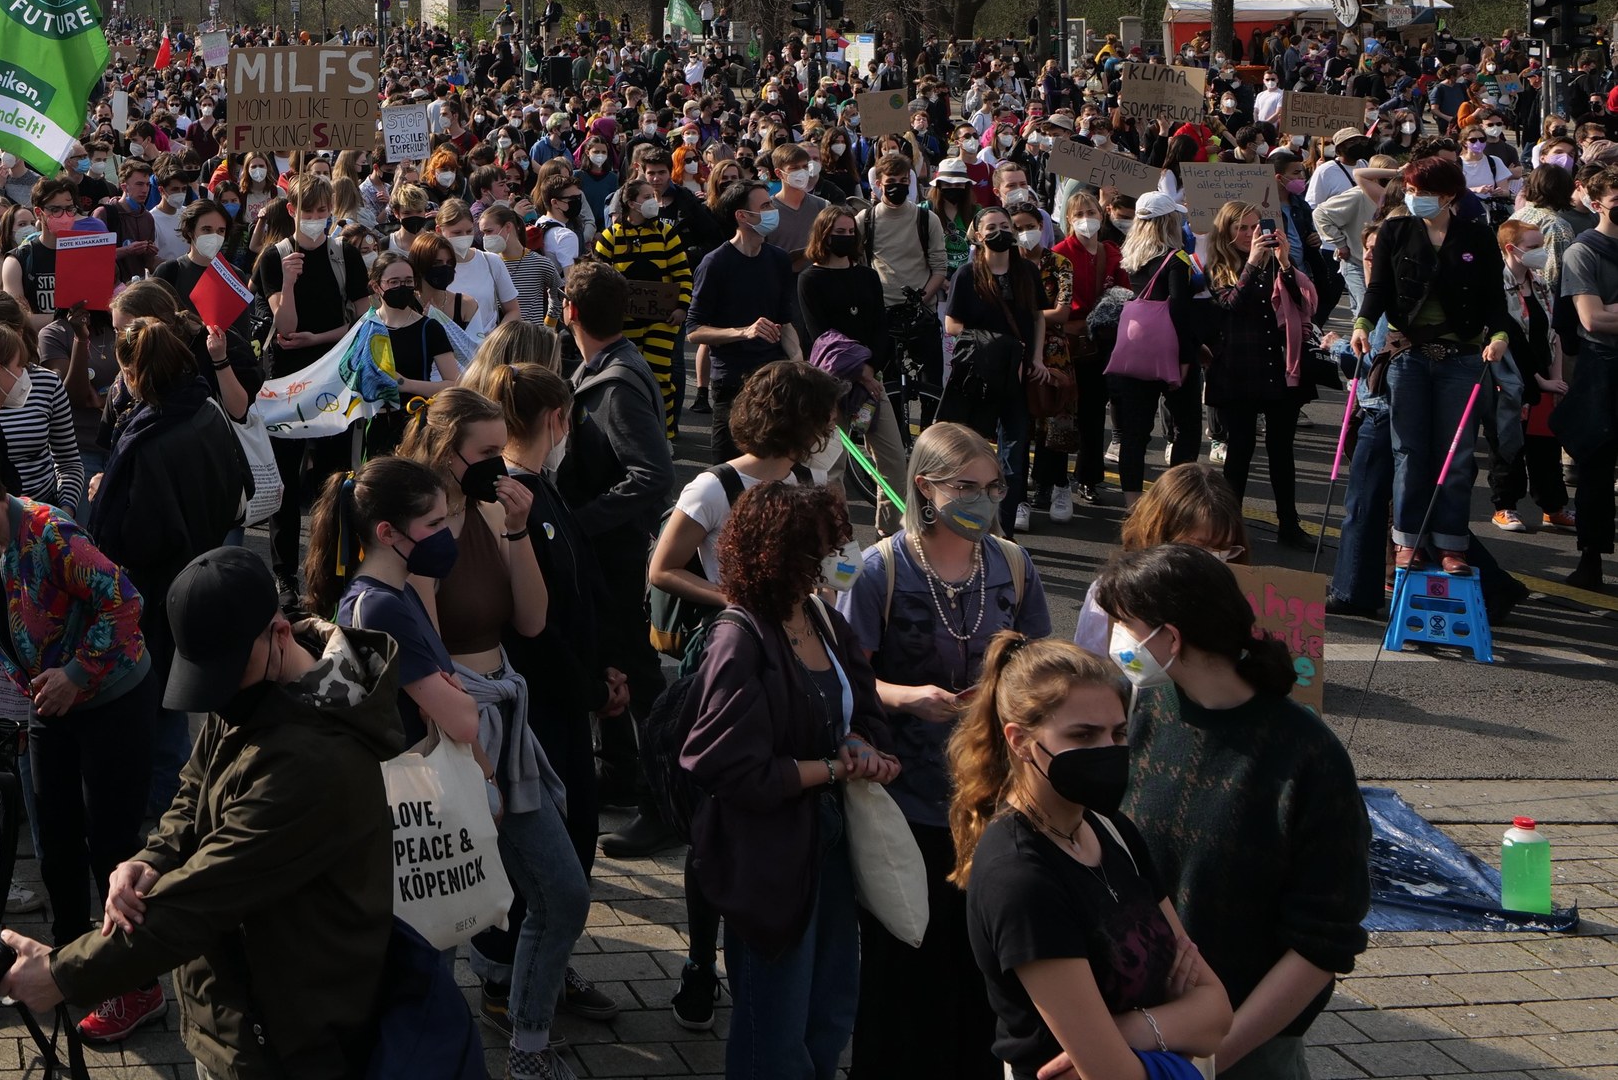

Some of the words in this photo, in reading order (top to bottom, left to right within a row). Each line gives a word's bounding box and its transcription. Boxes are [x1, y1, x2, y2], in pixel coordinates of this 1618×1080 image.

[234, 49, 375, 95] MILFS
[1128, 64, 1187, 86] KLIMA
[237, 99, 271, 120] MOM
[299, 97, 331, 119] LIKE
[342, 99, 369, 118] TO
[1120, 102, 1203, 123] SOMMERLOCH
[1290, 94, 1354, 117] ENERGIE
[386, 112, 424, 129] STOP
[1291, 116, 1315, 128] BITTE
[234, 124, 307, 150] FUCKING
[313, 122, 365, 149] SAVE
[389, 132, 428, 144] FOSSILEN
[390, 143, 429, 154] IMPERIUM
[1057, 141, 1091, 162] GANZ
[1101, 150, 1149, 179] DÜNNES
[1089, 167, 1117, 186] EIS
[1182, 166, 1209, 177] Hier
[1213, 167, 1234, 181] geht
[1236, 167, 1270, 182] gerade
[1197, 181, 1222, 189] alles
[1224, 180, 1252, 192] bergab
[1214, 191, 1242, 202] außer
[1190, 209, 1205, 218] die
[629, 283, 658, 297] Save
[390, 801, 442, 830] LOVE,
[394, 833, 454, 866] PEACE
[459, 828, 474, 853] &
[398, 856, 486, 902] KÖPENICK
[464, 915, 477, 930] ESK
